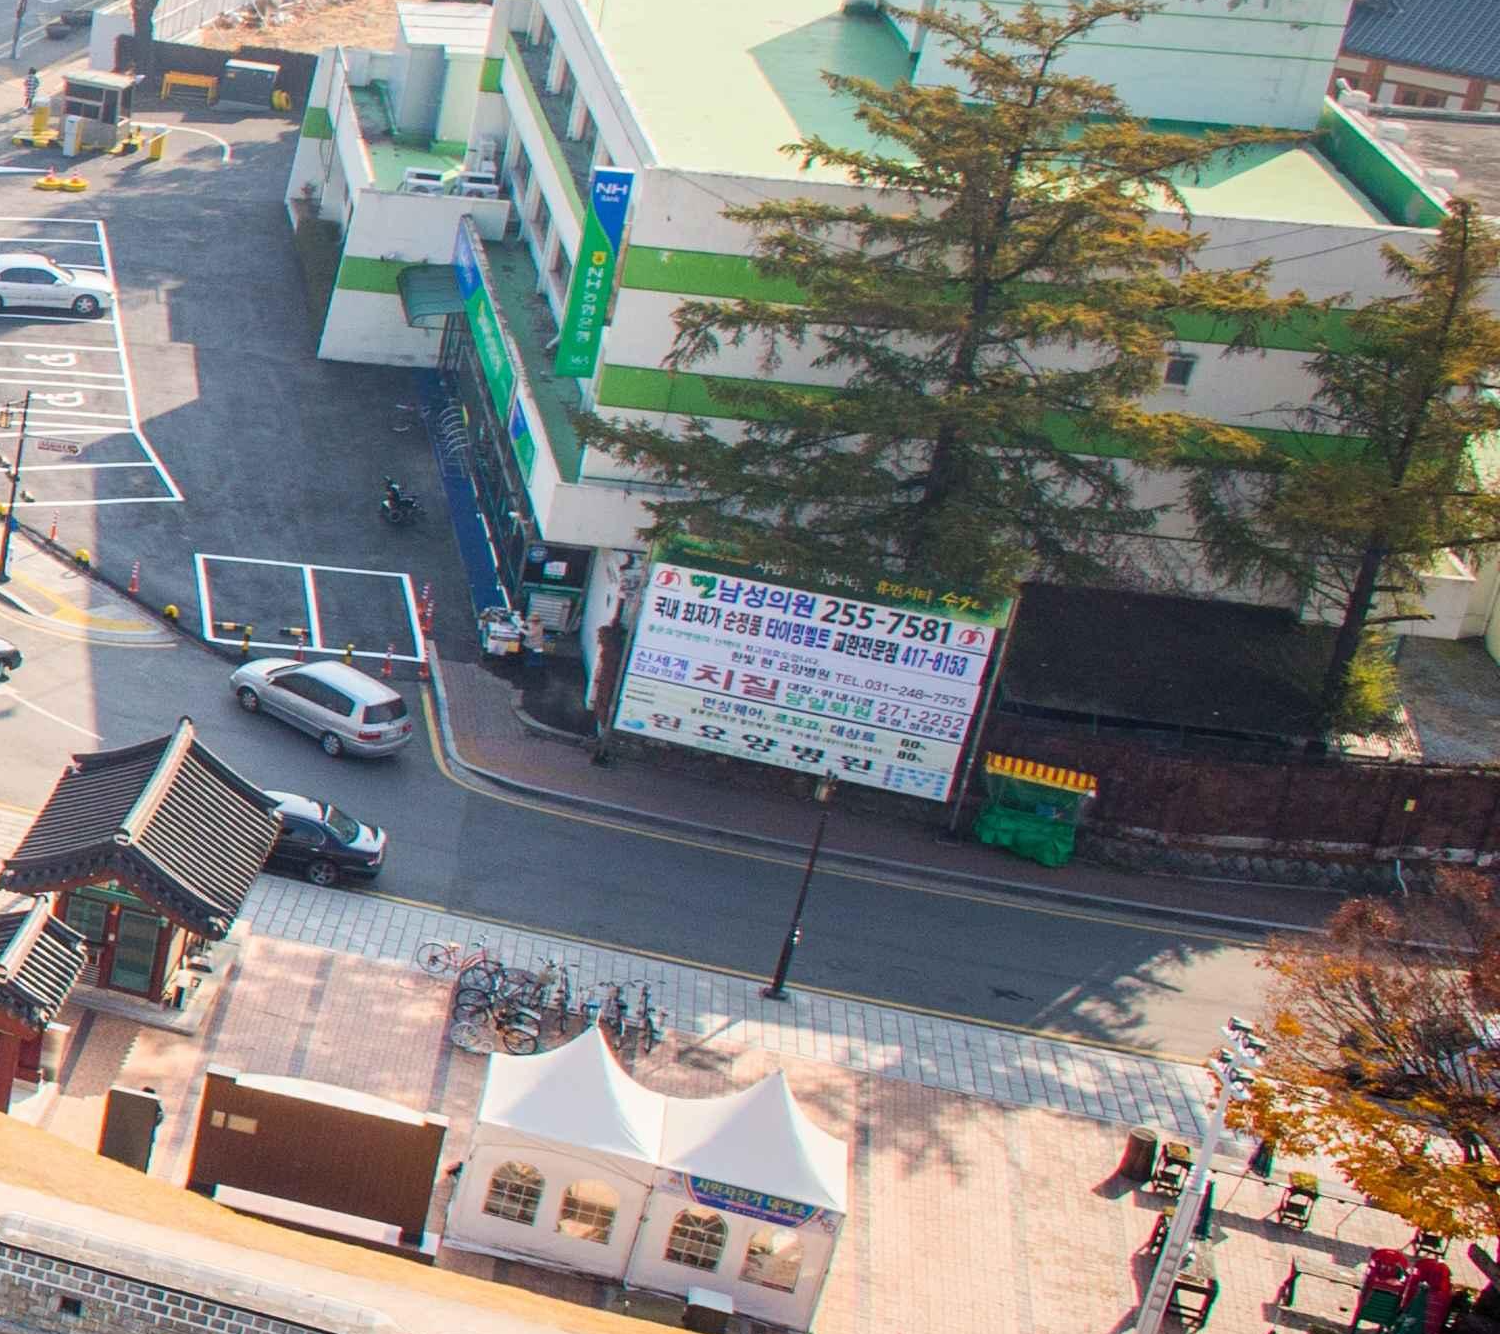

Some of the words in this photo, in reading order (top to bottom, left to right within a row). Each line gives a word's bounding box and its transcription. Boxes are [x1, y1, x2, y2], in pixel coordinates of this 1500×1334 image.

[596, 182, 628, 195] NH
[654, 595, 678, 620] 국내
[683, 601, 721, 628] 최저가
[723, 610, 763, 637] 순정품
[765, 618, 831, 650] 타이밍벨트
[832, 631, 901, 665] 교환전문점
[901, 645, 969, 678] 417-8153
[820, 599, 953, 645] 255-7581
[693, 664, 781, 701] 치질
[777, 660, 830, 682] 요양병원
[876, 701, 966, 732] 271-2252
